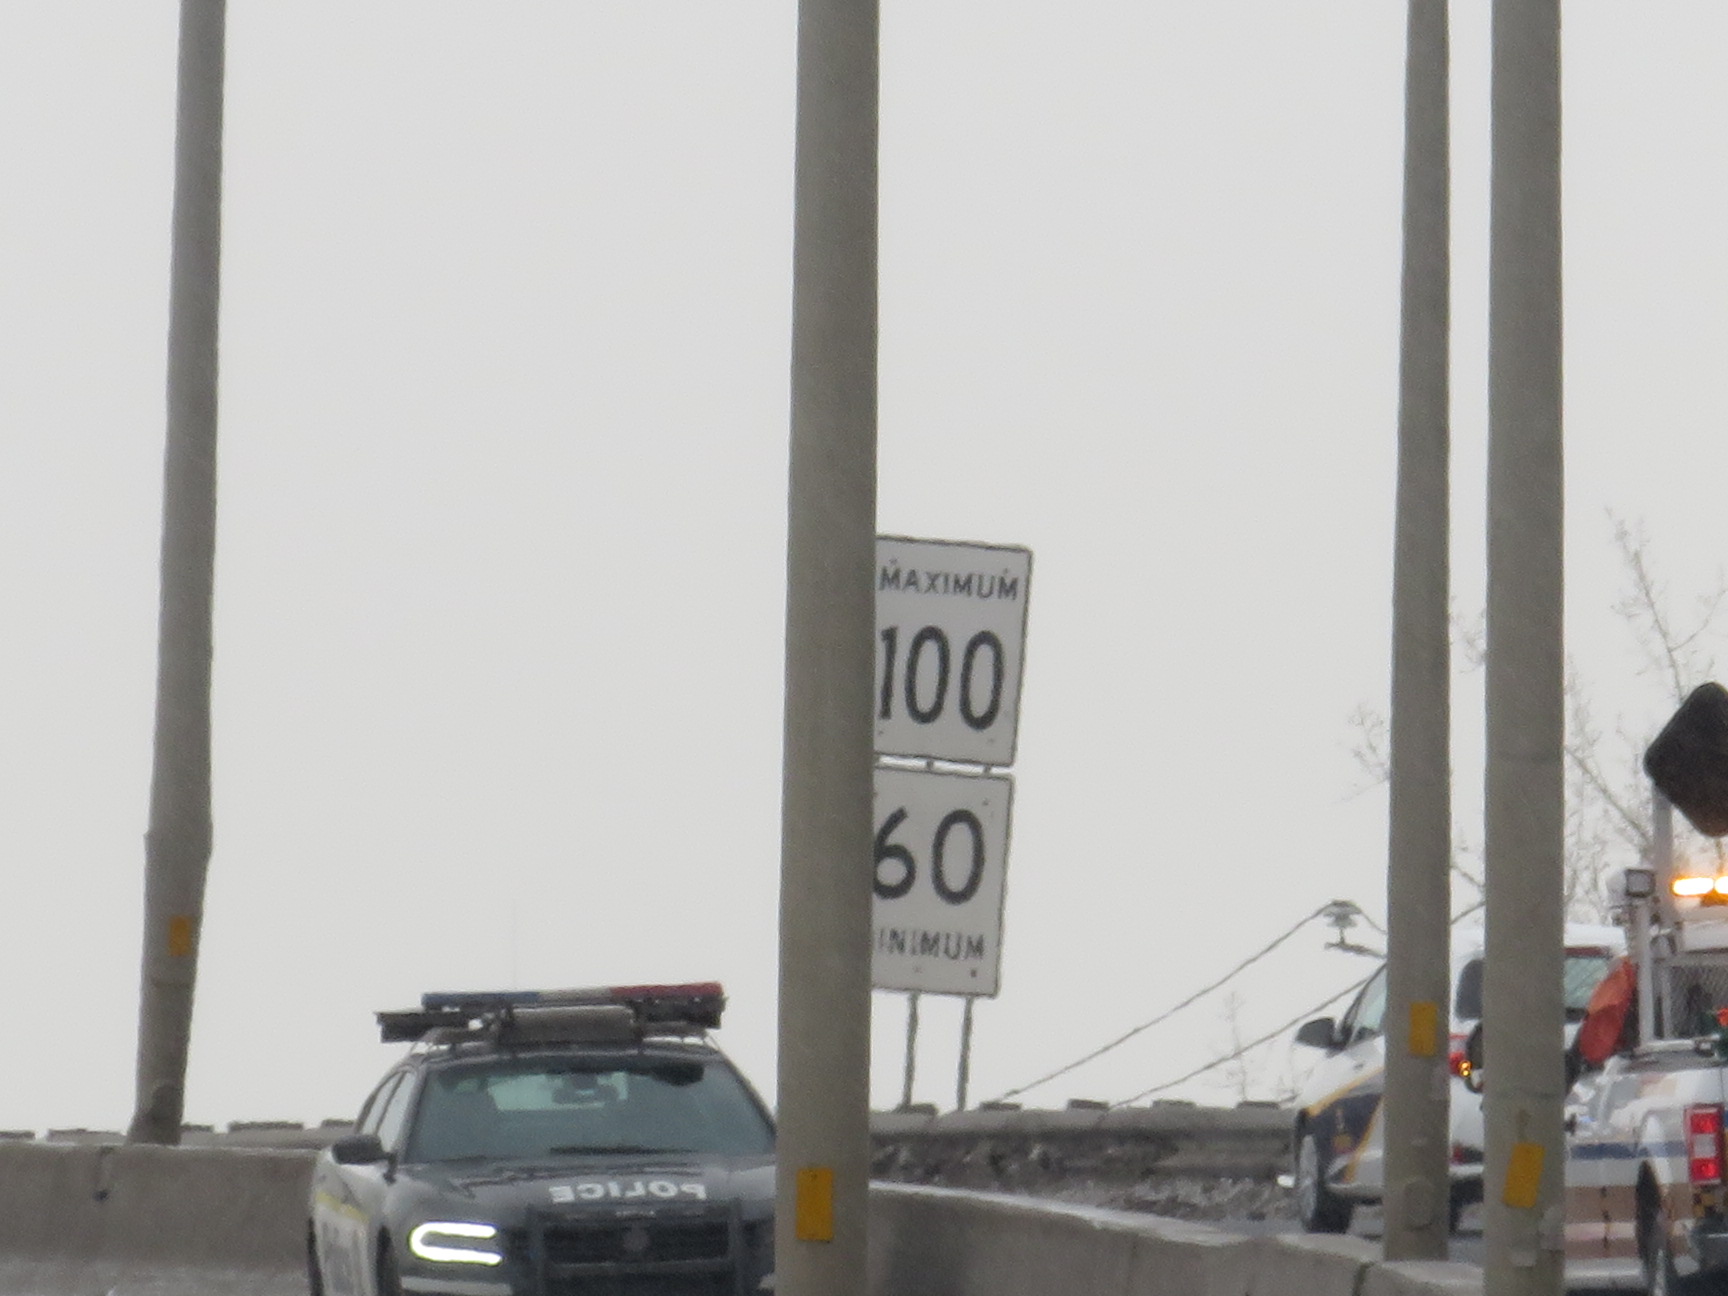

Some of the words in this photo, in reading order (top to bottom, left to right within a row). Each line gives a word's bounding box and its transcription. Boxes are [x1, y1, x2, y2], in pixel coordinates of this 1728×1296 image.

[878, 566, 1019, 601] MAXIMUM
[879, 625, 1005, 731] 100
[873, 807, 985, 905] 60
[877, 927, 984, 960] INIMUM
